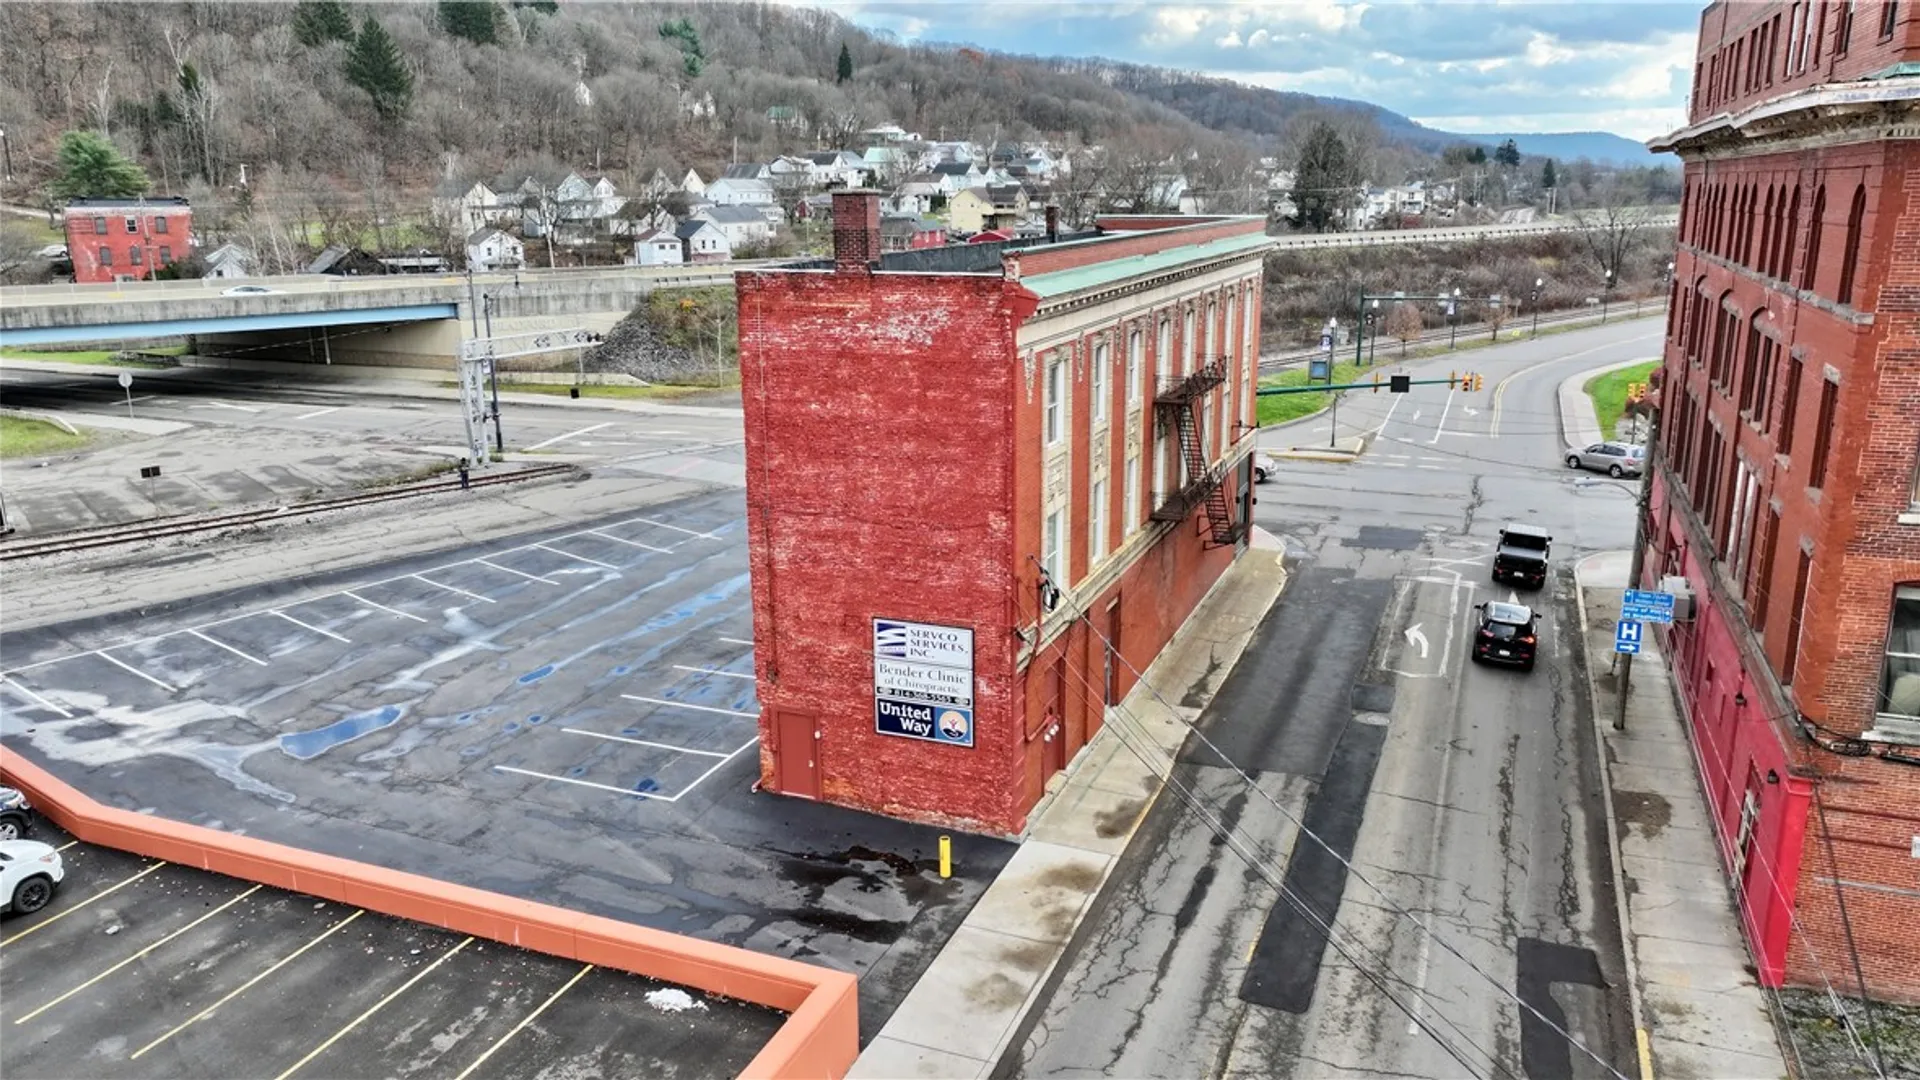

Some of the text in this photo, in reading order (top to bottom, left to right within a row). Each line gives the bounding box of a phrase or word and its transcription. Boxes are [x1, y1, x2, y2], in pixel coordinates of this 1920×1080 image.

[910, 629, 958, 642] SERVCO
[1621, 623, 1638, 640] H
[910, 639, 968, 654] SERVICES,
[910, 648, 935, 659] INC.
[879, 663, 966, 684] Bender Clinic
[884, 677, 960, 694] of Chiropractic
[879, 702, 931, 721] United
[899, 717, 932, 736] Way
